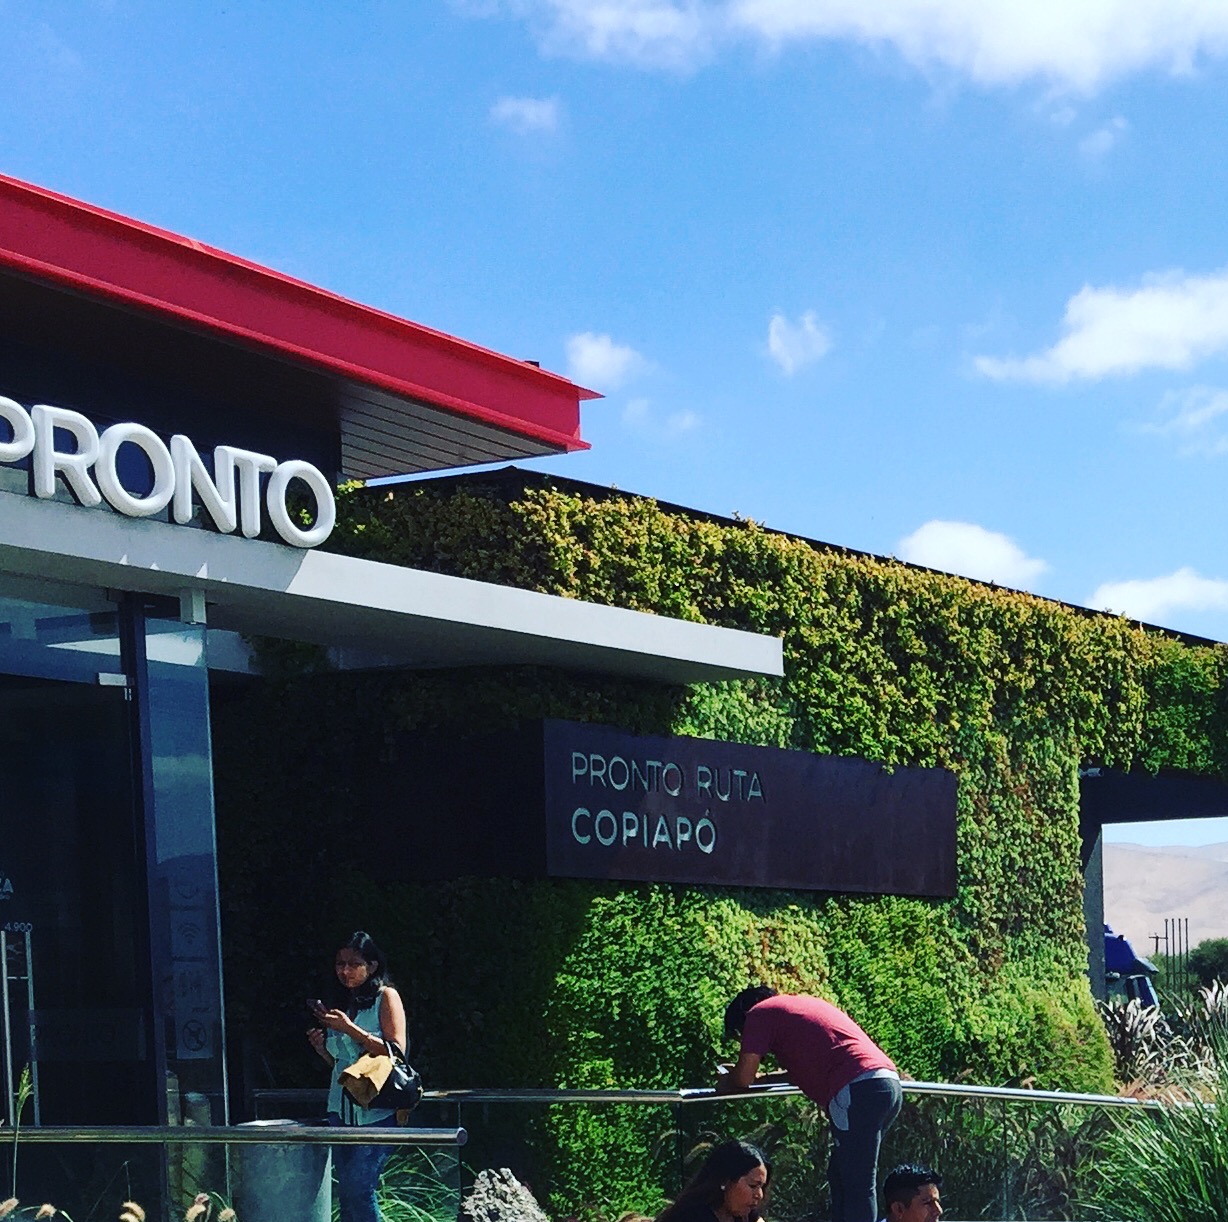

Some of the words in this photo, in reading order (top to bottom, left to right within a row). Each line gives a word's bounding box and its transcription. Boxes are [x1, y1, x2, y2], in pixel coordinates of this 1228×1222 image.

[0, 396, 336, 548] PRONTO
[572, 751, 684, 797] PRONTO
[697, 765, 766, 803] RUTA
[571, 807, 717, 854] COPIAPÓ
